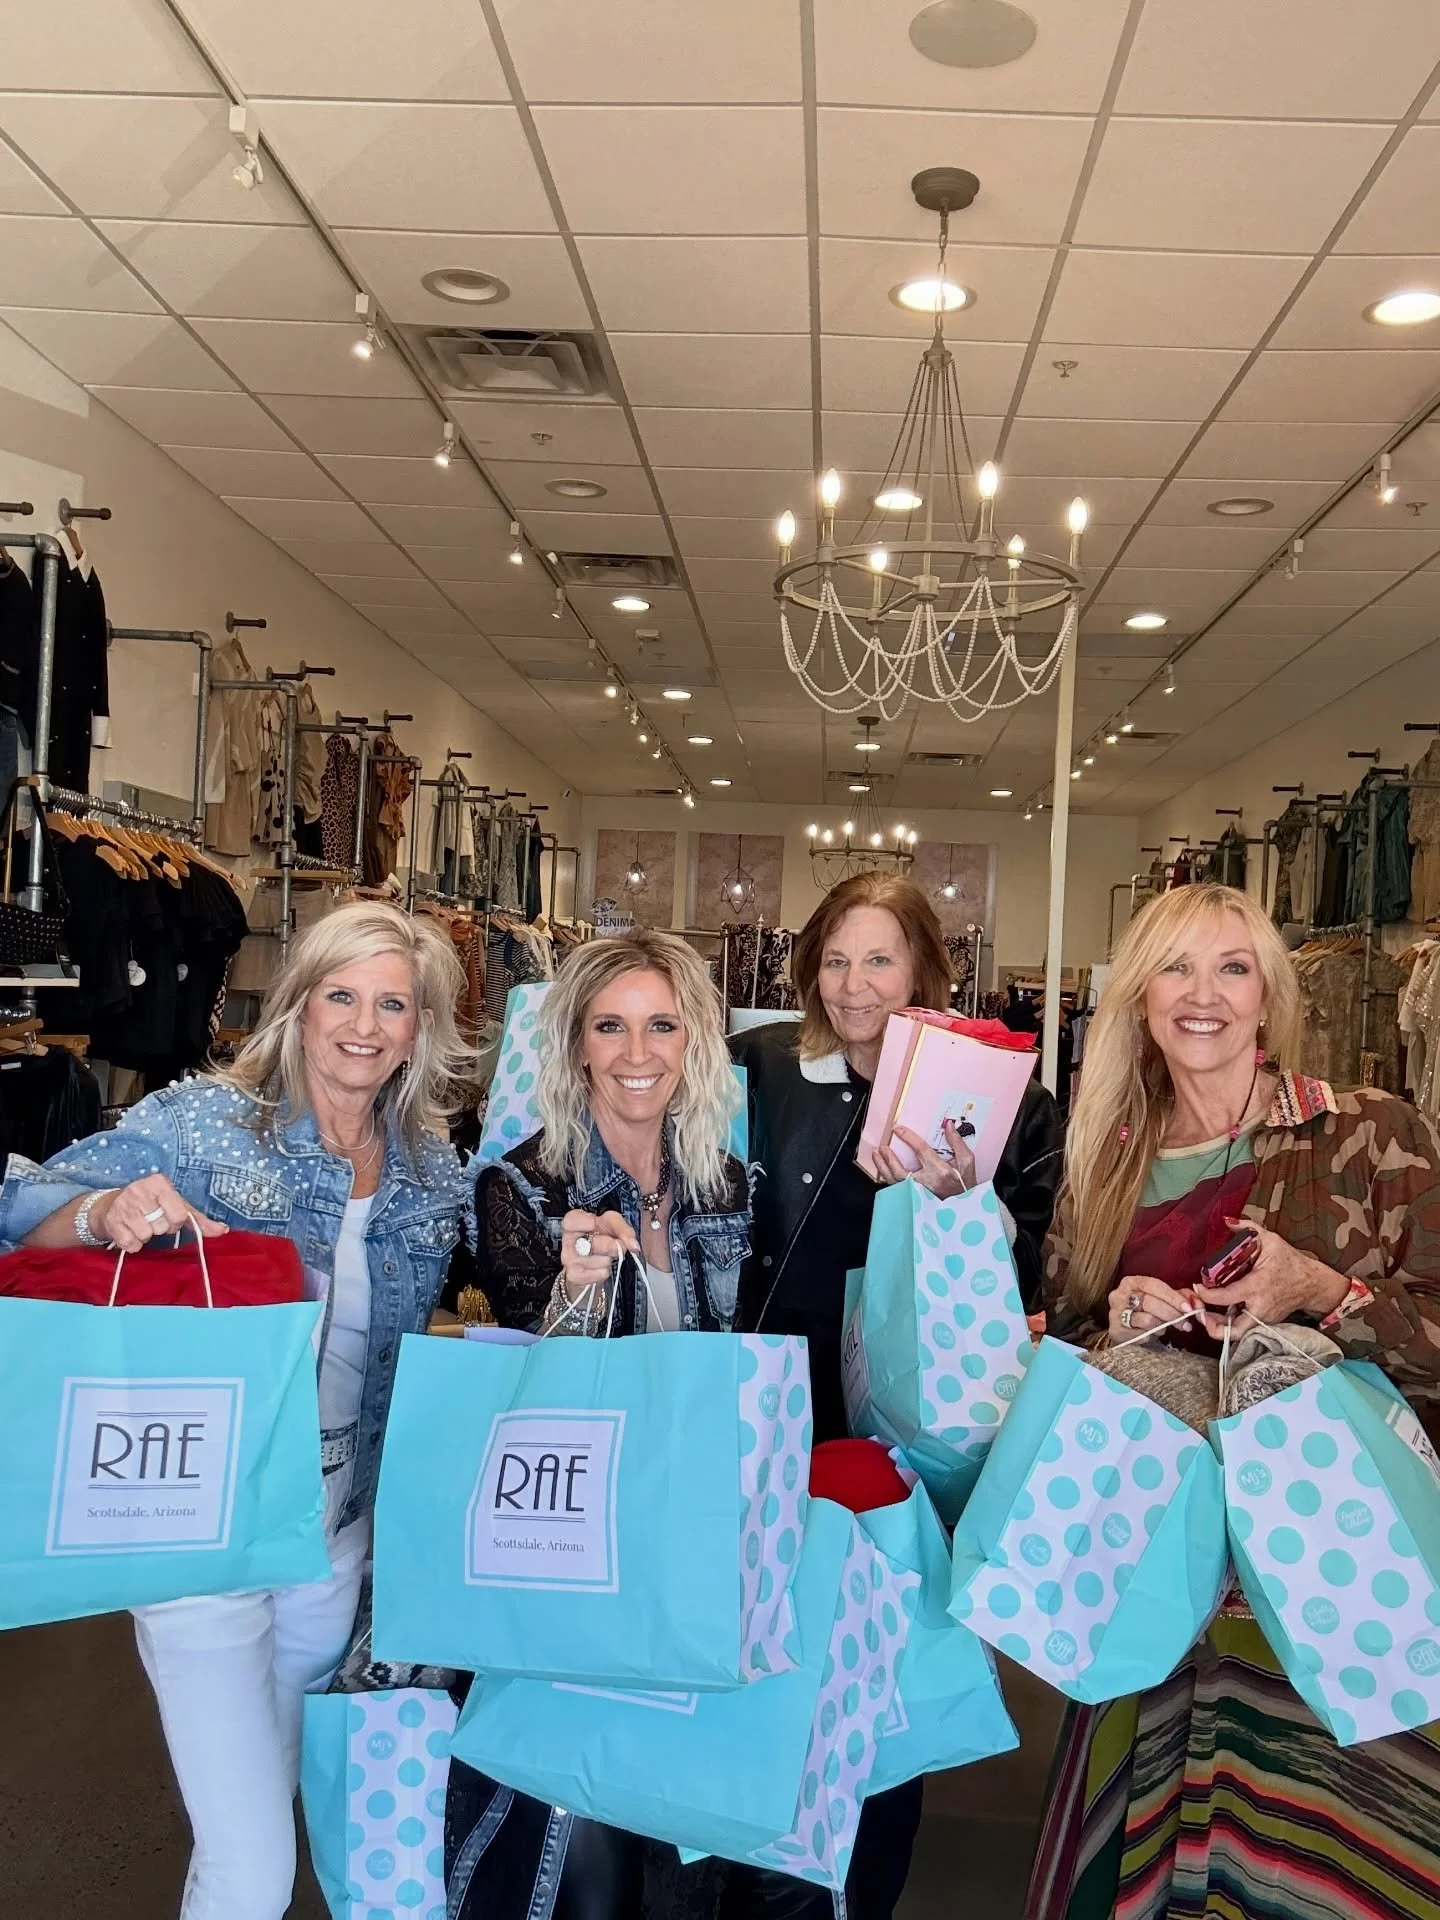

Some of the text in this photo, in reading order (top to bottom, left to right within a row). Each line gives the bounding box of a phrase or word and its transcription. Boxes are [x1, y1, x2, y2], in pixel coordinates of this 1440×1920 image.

[596, 917, 630, 928] DENIM
[91, 1422, 205, 1479] RAE
[495, 1453, 588, 1512] RAE
[87, 1506, 196, 1518] Scottsdale, Arizona
[493, 1537, 585, 1553] Scottsdale, Arizona
